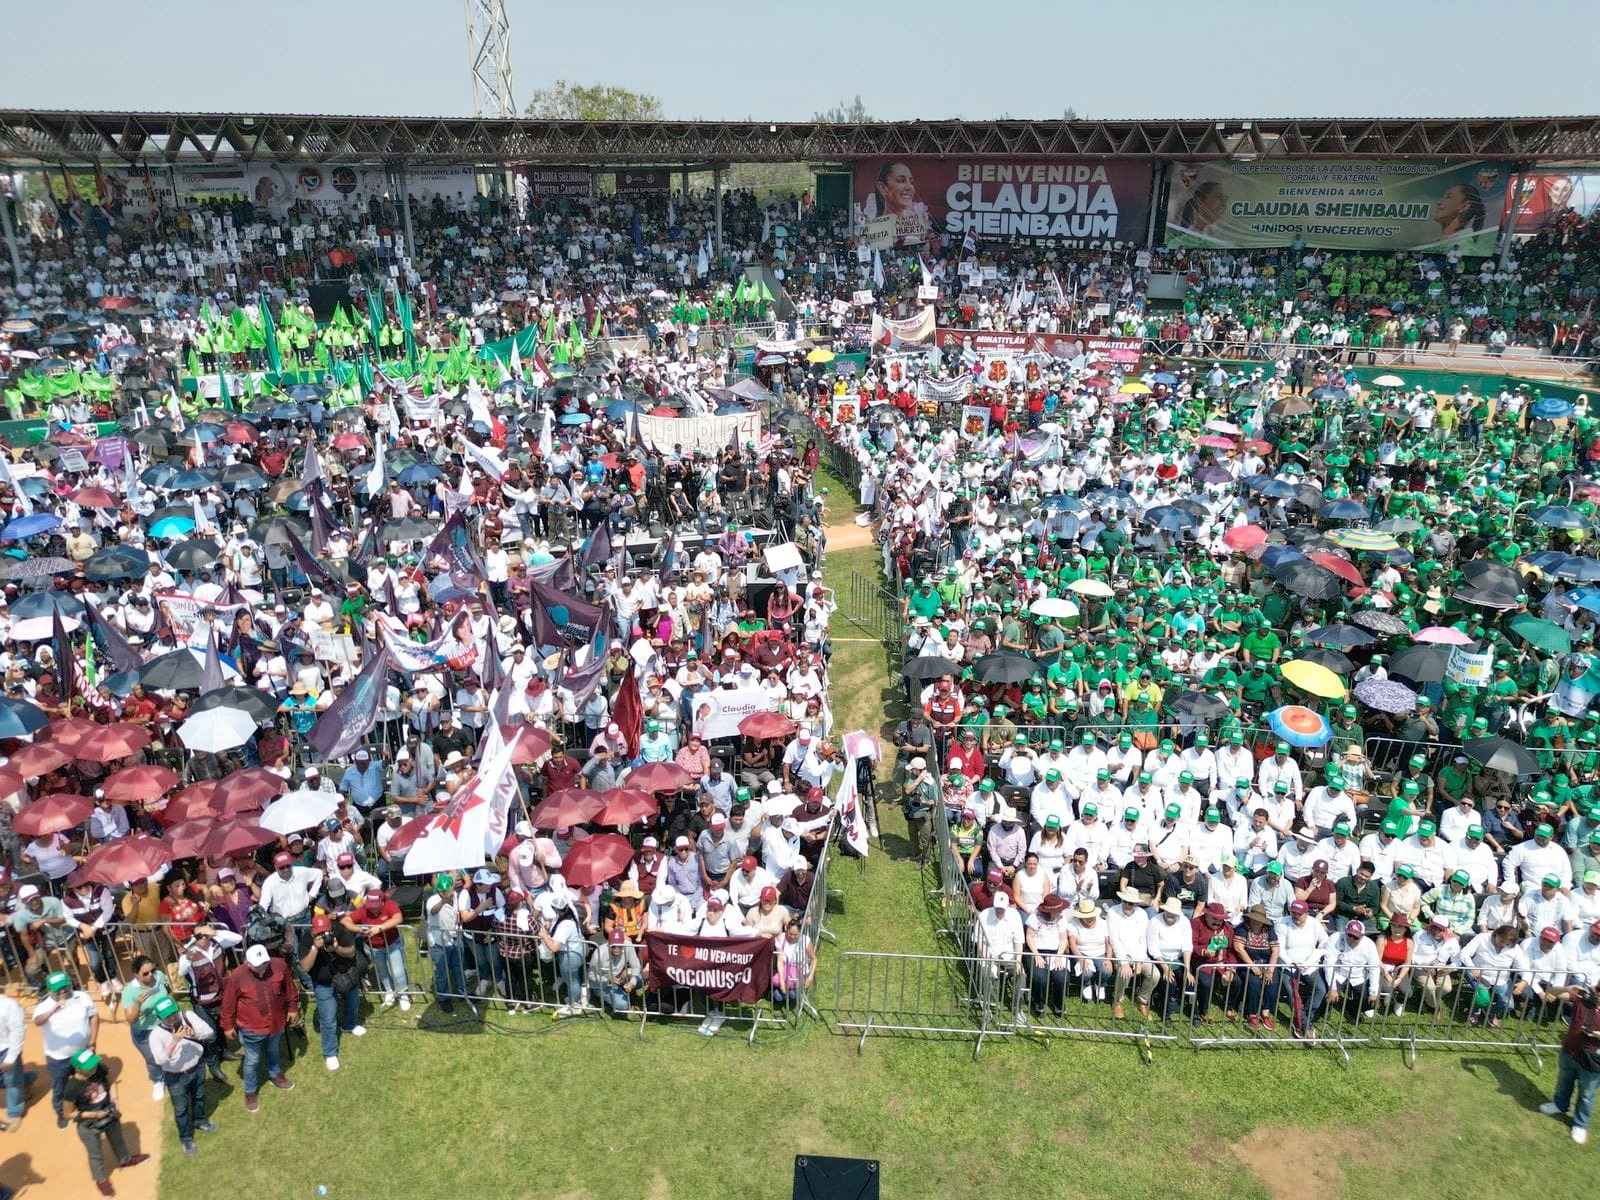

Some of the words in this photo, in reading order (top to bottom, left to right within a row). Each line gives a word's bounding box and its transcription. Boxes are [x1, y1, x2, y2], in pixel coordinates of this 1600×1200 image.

[958, 165, 1108, 183] BIENVENIDA
[1232, 165, 1248, 174] LOS
[1250, 165, 1303, 174] PETROLEROS
[1304, 165, 1316, 173] DE
[1318, 165, 1328, 173] LA
[1330, 165, 1352, 173] ZONA
[1354, 165, 1371, 173] SUR
[1386, 165, 1418, 174] DAMOS
[1419, 165, 1437, 174] UNA
[534, 172, 558, 182] CLAUDIA
[1285, 174, 1319, 182] CORDIAL
[1332, 174, 1380, 182] FRATERNAL
[1278, 188, 1345, 196] BIENVENIDA
[1347, 188, 1385, 196] AMIGA
[946, 182, 1119, 215] CLAUDIA
[1231, 202, 1310, 217] CLAUDIA
[1314, 203, 1430, 219] SHEINBAUM
[945, 211, 1118, 238] SHEINBAUM
[896, 225, 926, 235] HUERTA
[976, 335, 1026, 345] MINATITLÁN
[1088, 340, 1141, 350] MINATITLÁN
[637, 414, 739, 445] CLAUDIA
[722, 703, 757, 713] Claudia
[667, 944, 679, 956] TE
[710, 949, 754, 966] VERACRUZ
